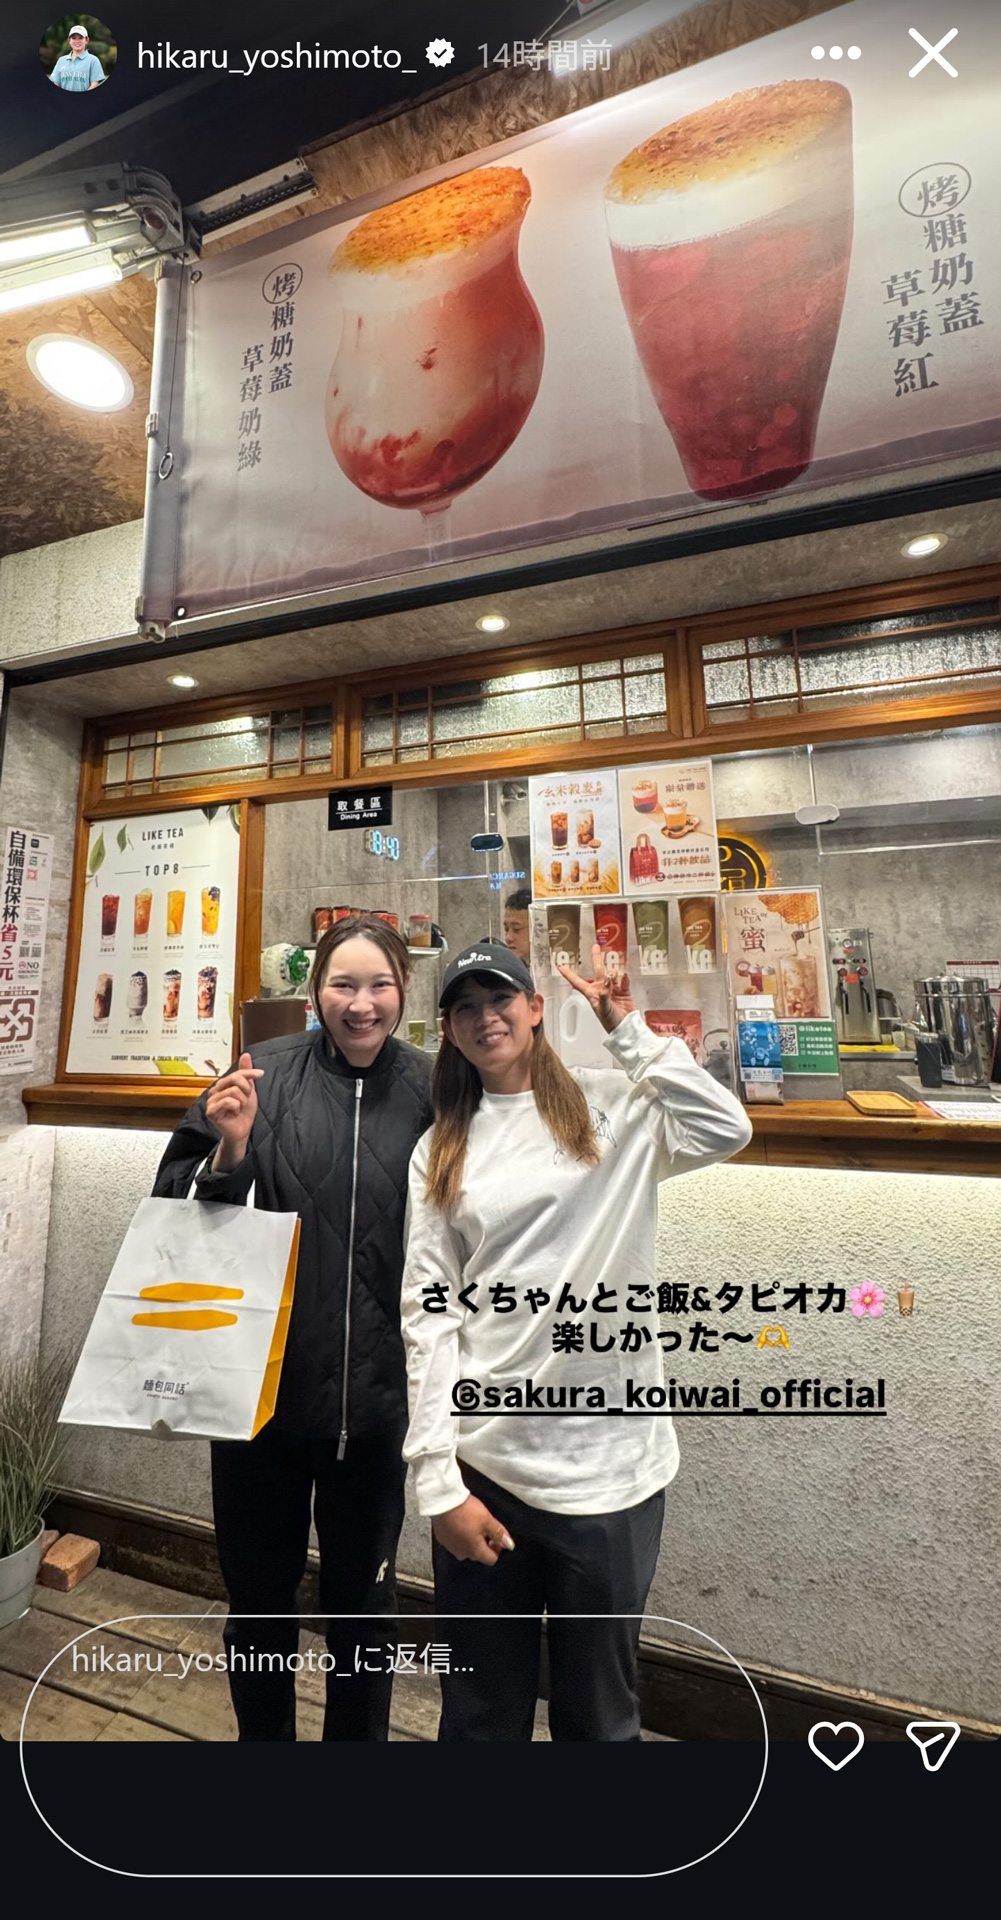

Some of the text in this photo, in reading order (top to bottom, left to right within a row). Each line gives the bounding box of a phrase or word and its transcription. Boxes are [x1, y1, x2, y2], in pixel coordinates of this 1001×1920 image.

[917, 174, 984, 335] 烤糖奶蓋
[268, 272, 296, 394] 烤糖奶蓋
[881, 269, 939, 397] 草莓紅
[237, 344, 264, 472] 草莓奶綠
[336, 796, 381, 811] 取餐區
[142, 828, 184, 841] LIKE TEA
[734, 907, 757, 916] LIKE
[742, 915, 761, 924] TEA
[741, 927, 765, 953] 蜜
